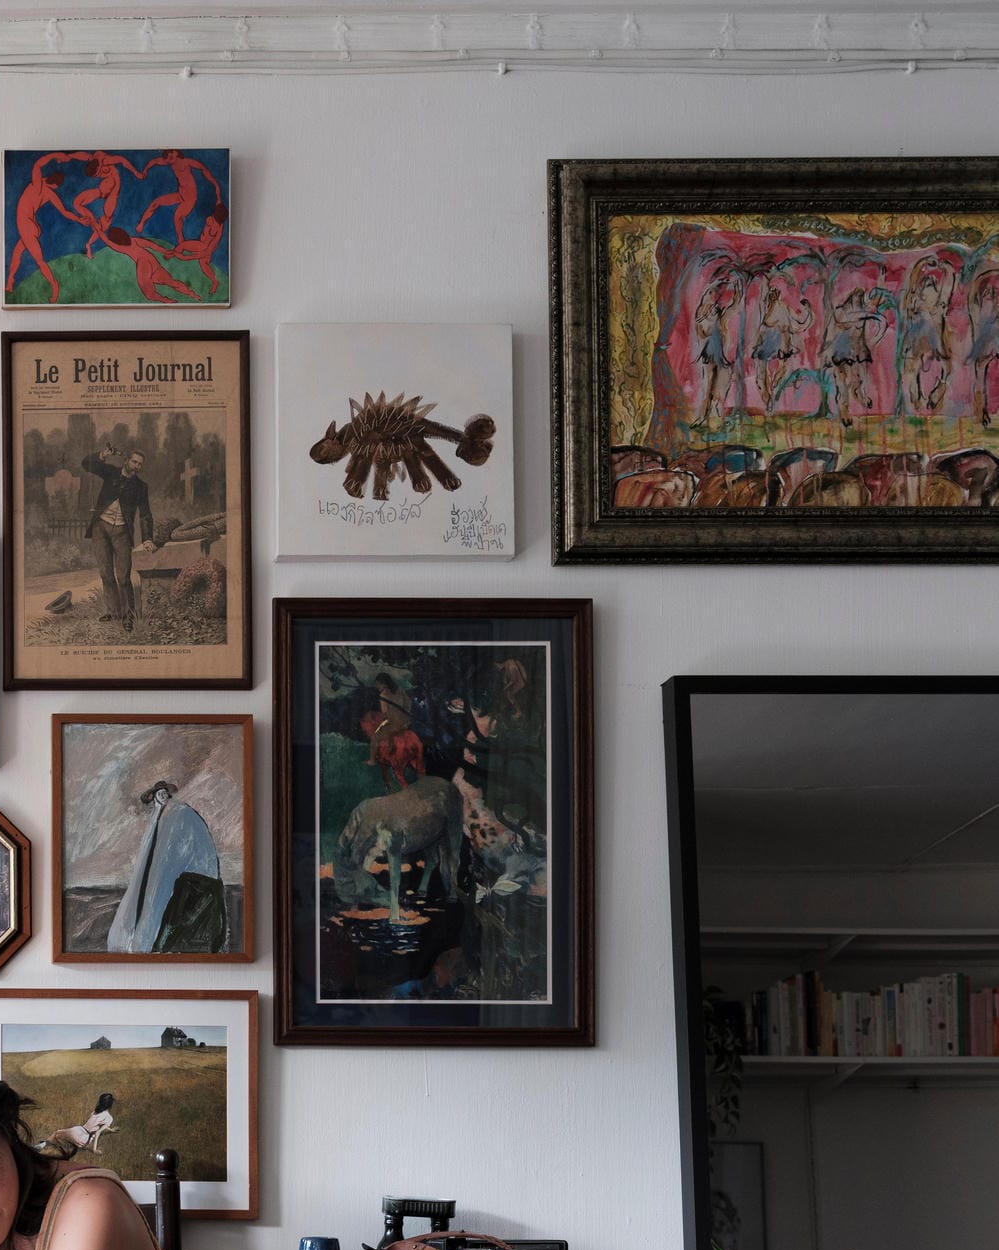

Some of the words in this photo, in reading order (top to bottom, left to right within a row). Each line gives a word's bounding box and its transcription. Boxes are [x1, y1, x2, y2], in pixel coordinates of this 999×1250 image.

[35, 359, 59, 384] Le
[73, 357, 119, 383] Petit
[134, 356, 213, 382] Journal
